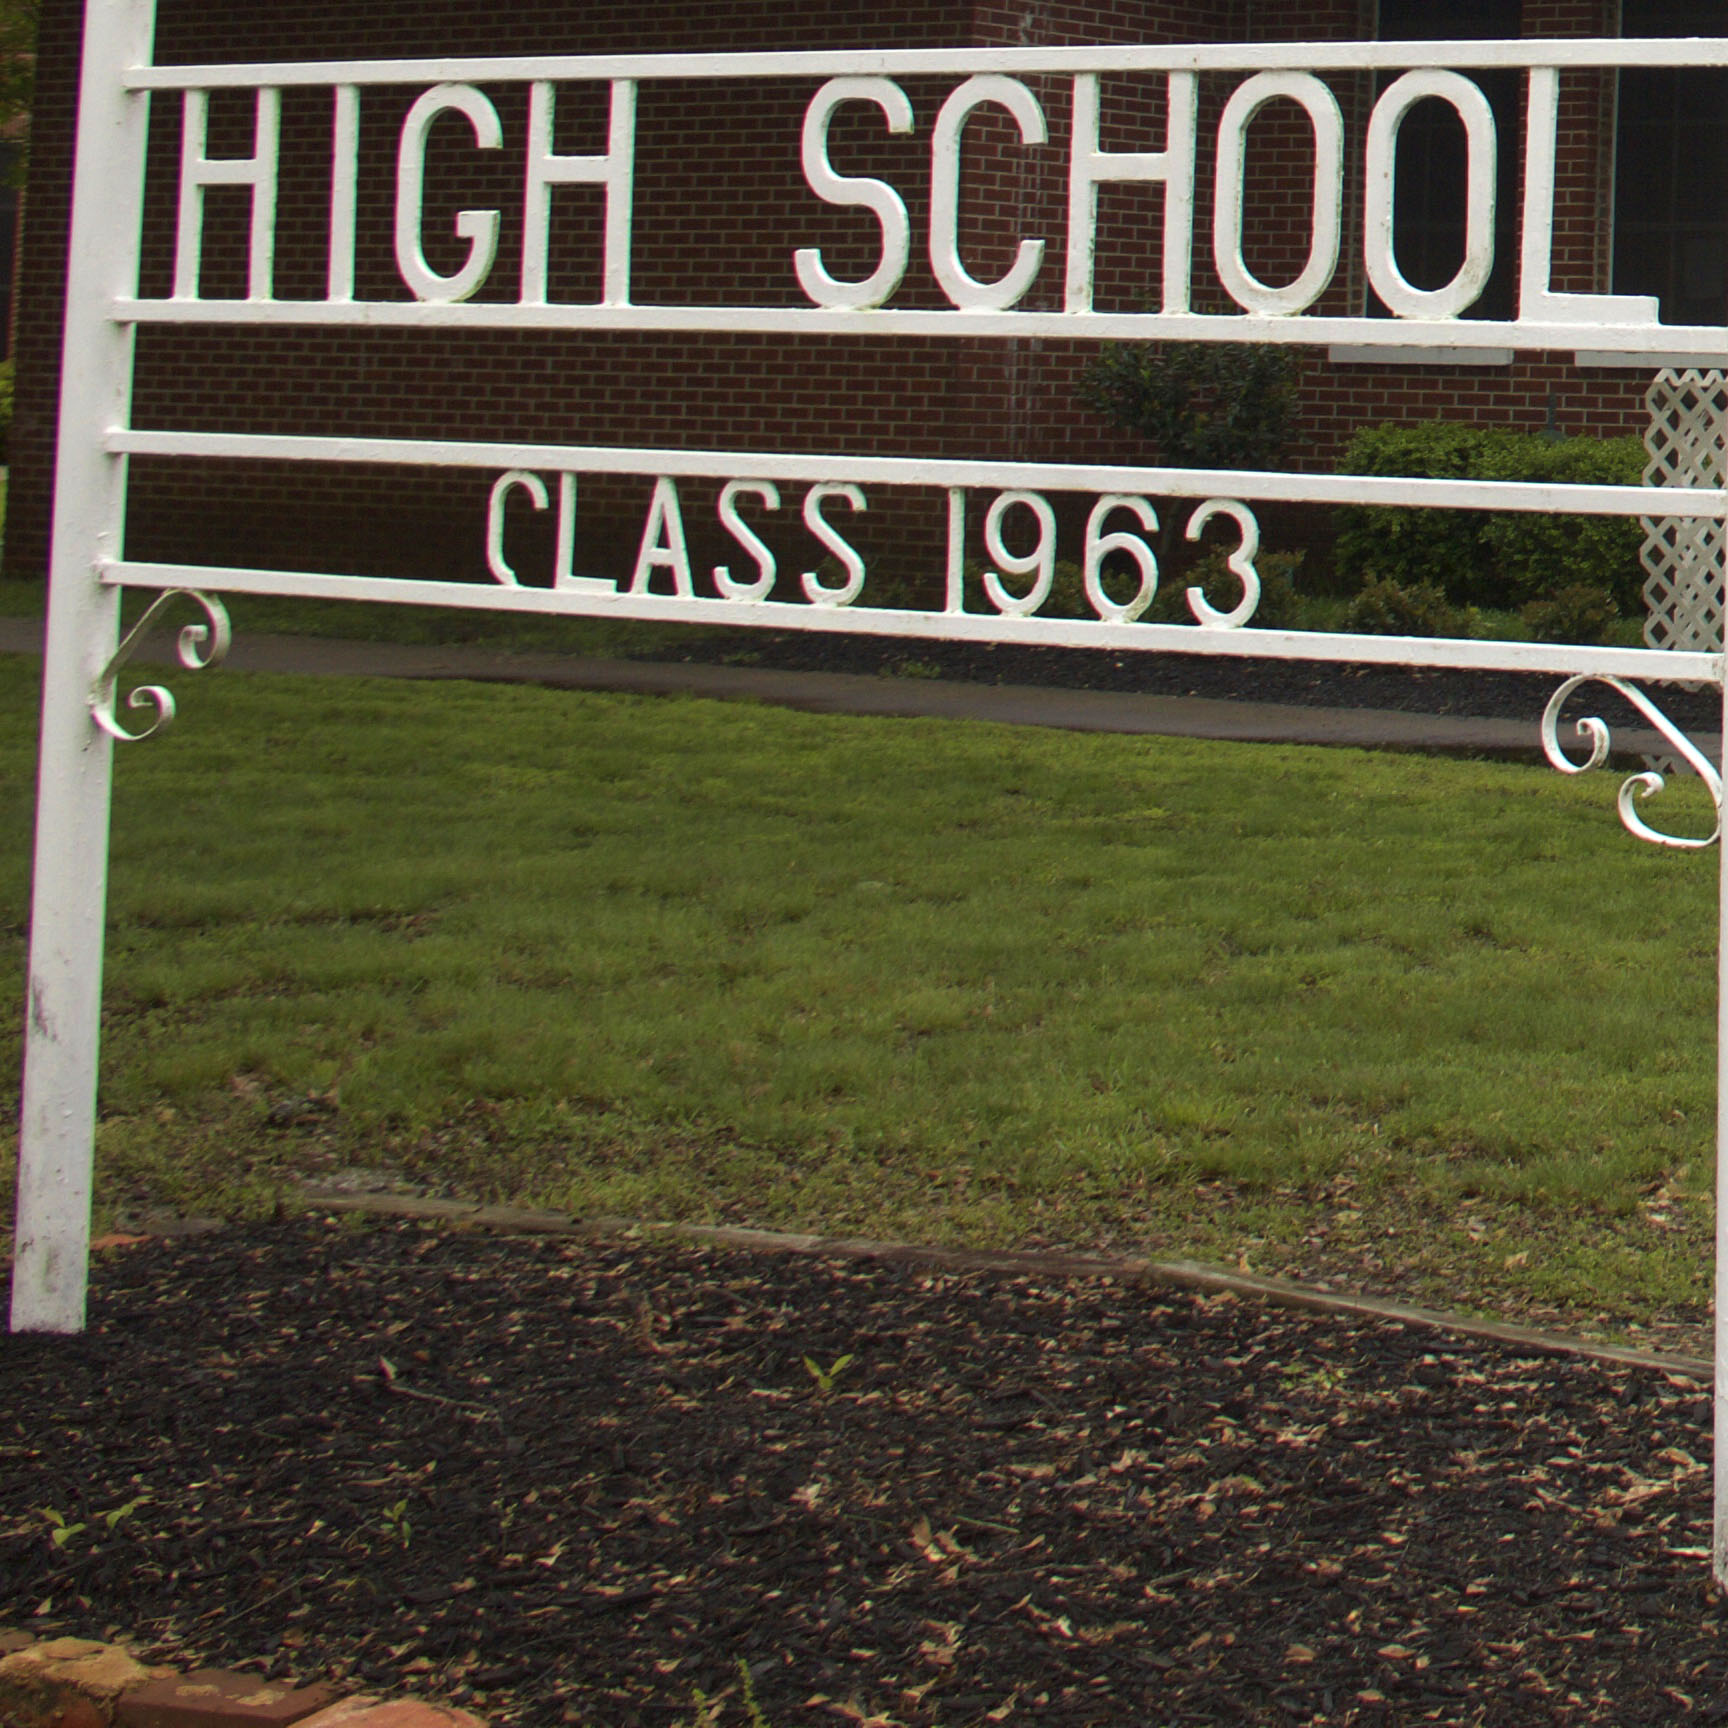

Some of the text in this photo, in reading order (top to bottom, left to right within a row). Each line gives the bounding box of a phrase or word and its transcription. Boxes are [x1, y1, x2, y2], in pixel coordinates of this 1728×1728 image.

[174, 67, 1660, 326] HIGH SCHOOL
[487, 470, 1261, 630] CLASS 1963
